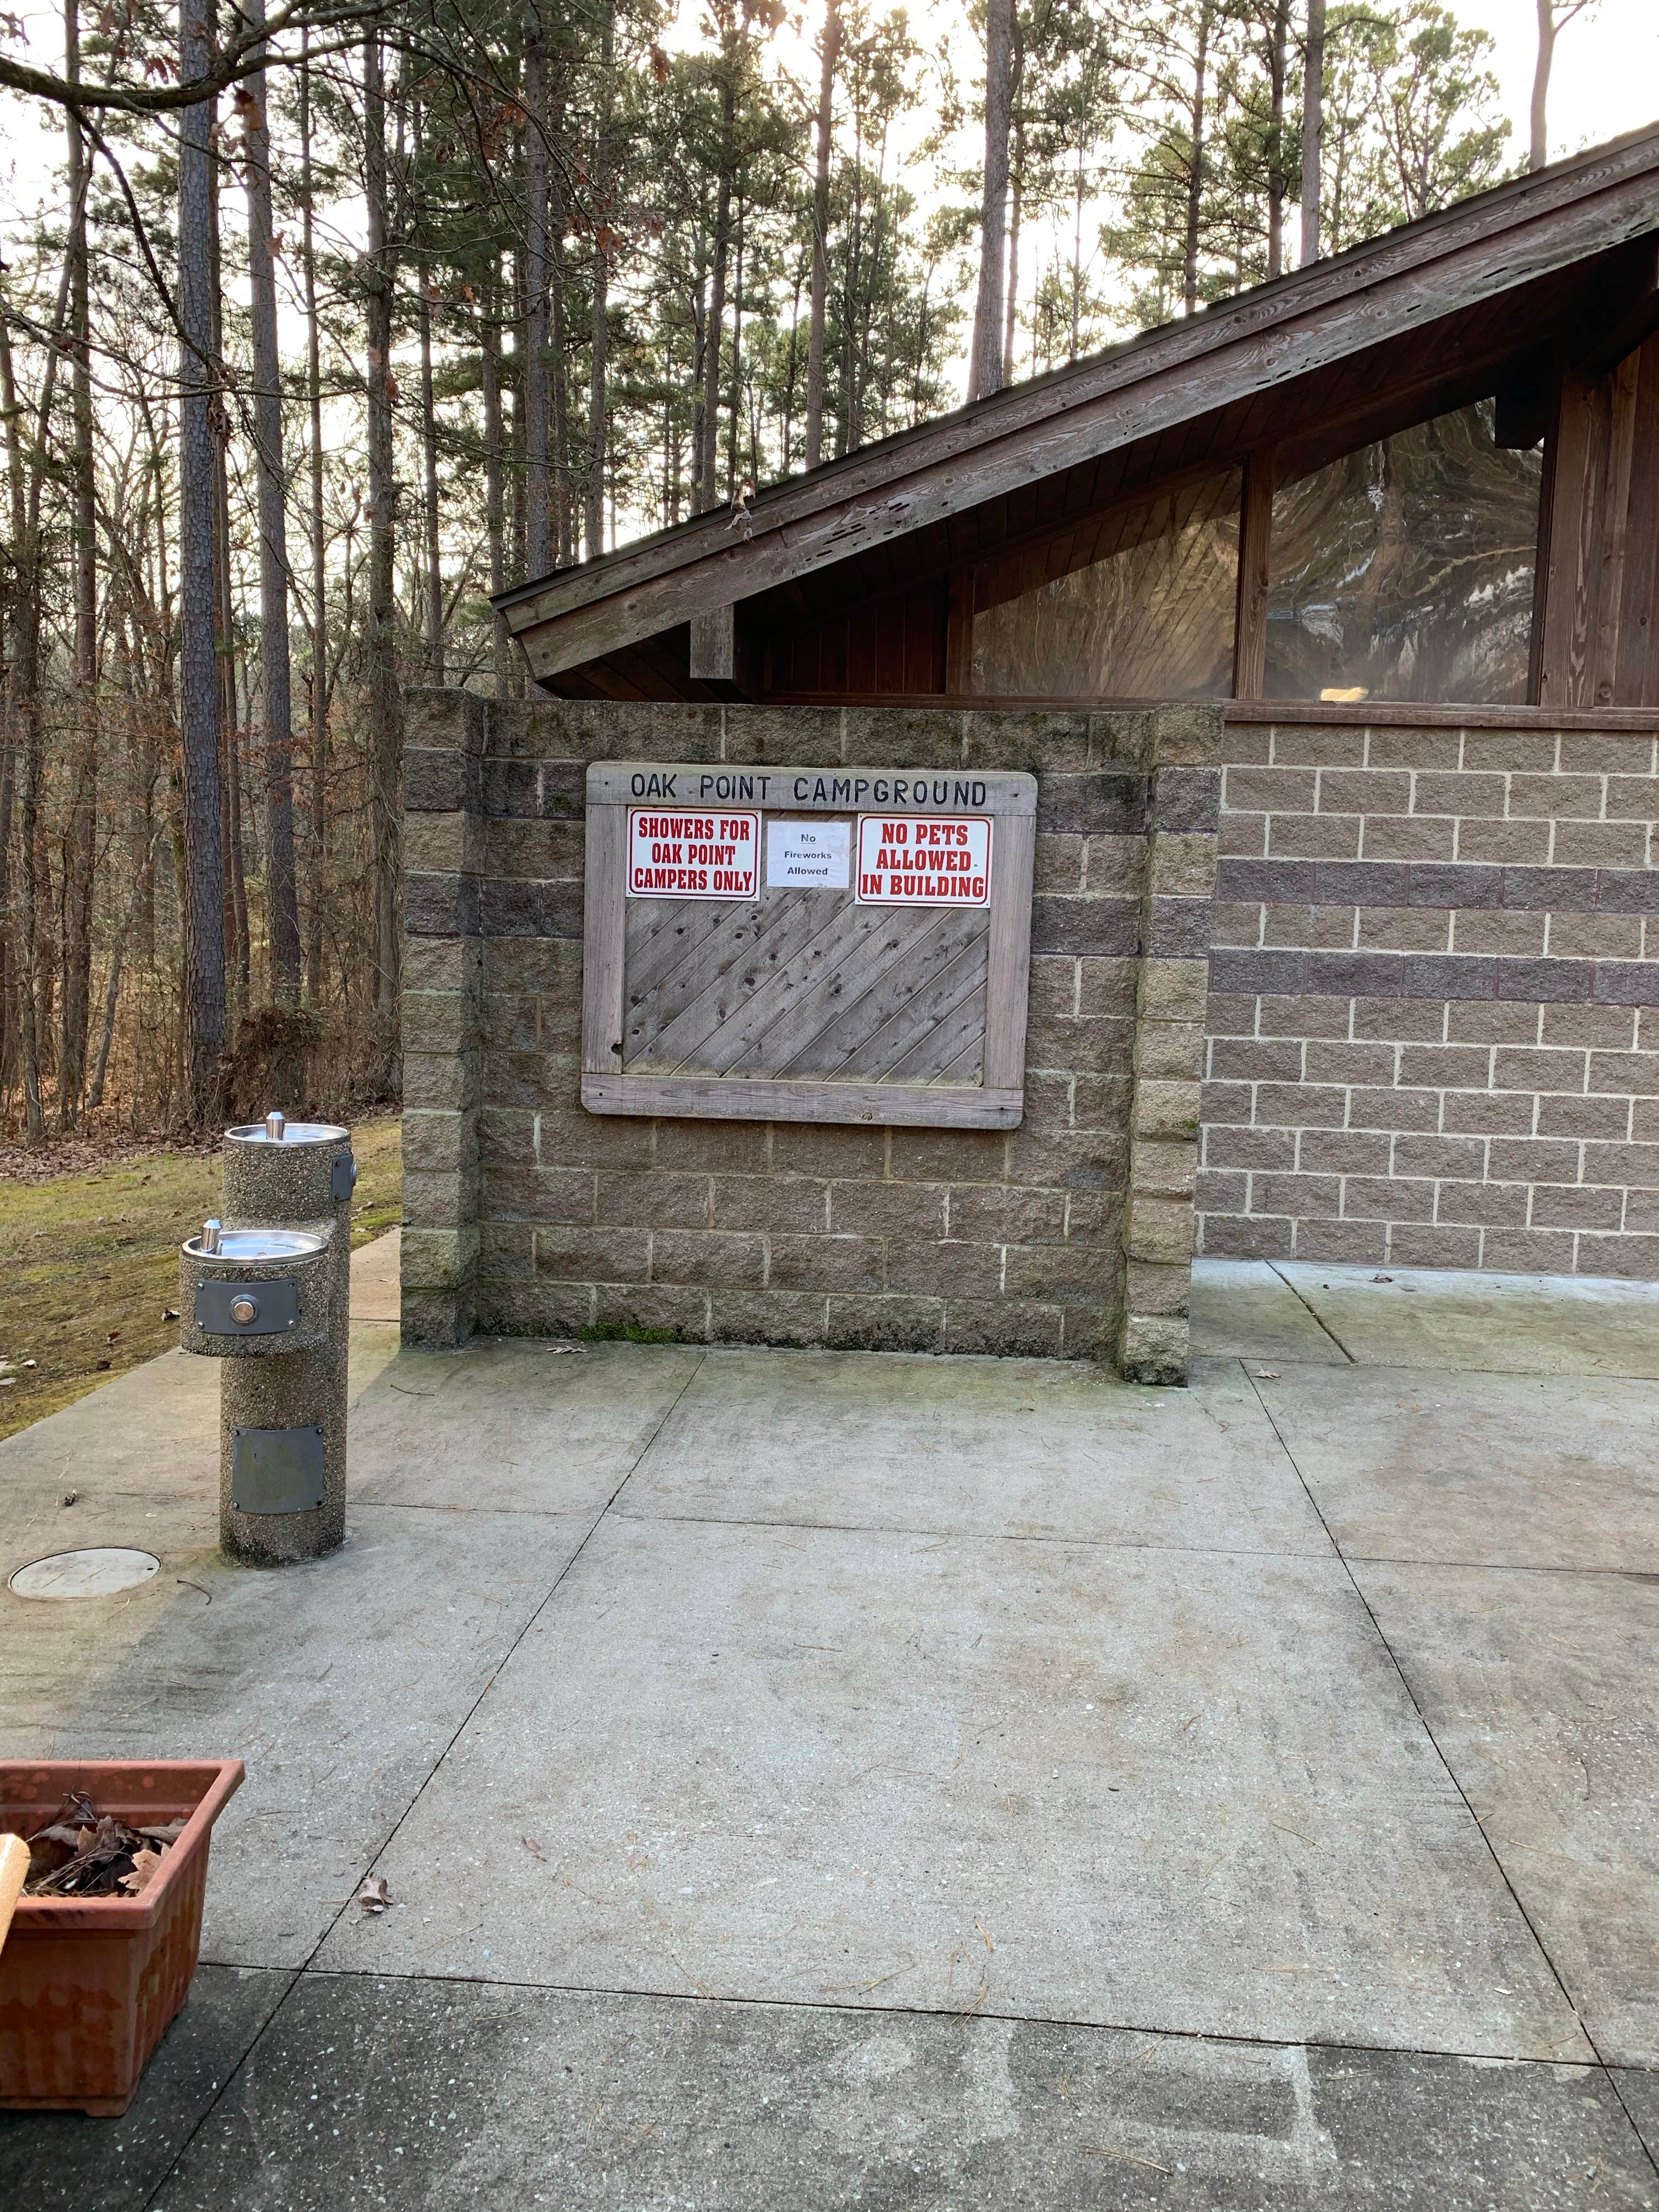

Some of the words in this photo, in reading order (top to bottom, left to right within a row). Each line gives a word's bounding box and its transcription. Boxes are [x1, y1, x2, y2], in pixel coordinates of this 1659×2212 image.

[631, 773, 677, 798] OAK
[700, 775, 771, 800] POINT
[794, 777, 986, 806] CAMPGROUND
[639, 817, 714, 840] SHOWERS
[720, 820, 750, 841] FOR
[801, 834, 816, 842] No
[882, 823, 907, 845] NO
[916, 825, 968, 845] PETS
[652, 843, 682, 865] OAK
[688, 844, 736, 866] POINT
[876, 849, 971, 872] ALLOWED
[635, 867, 707, 890] CAMPERS
[713, 870, 752, 892] ONLY
[787, 867, 828, 875] Allowed
[862, 874, 883, 895] IN
[890, 875, 984, 898] BUILDING
